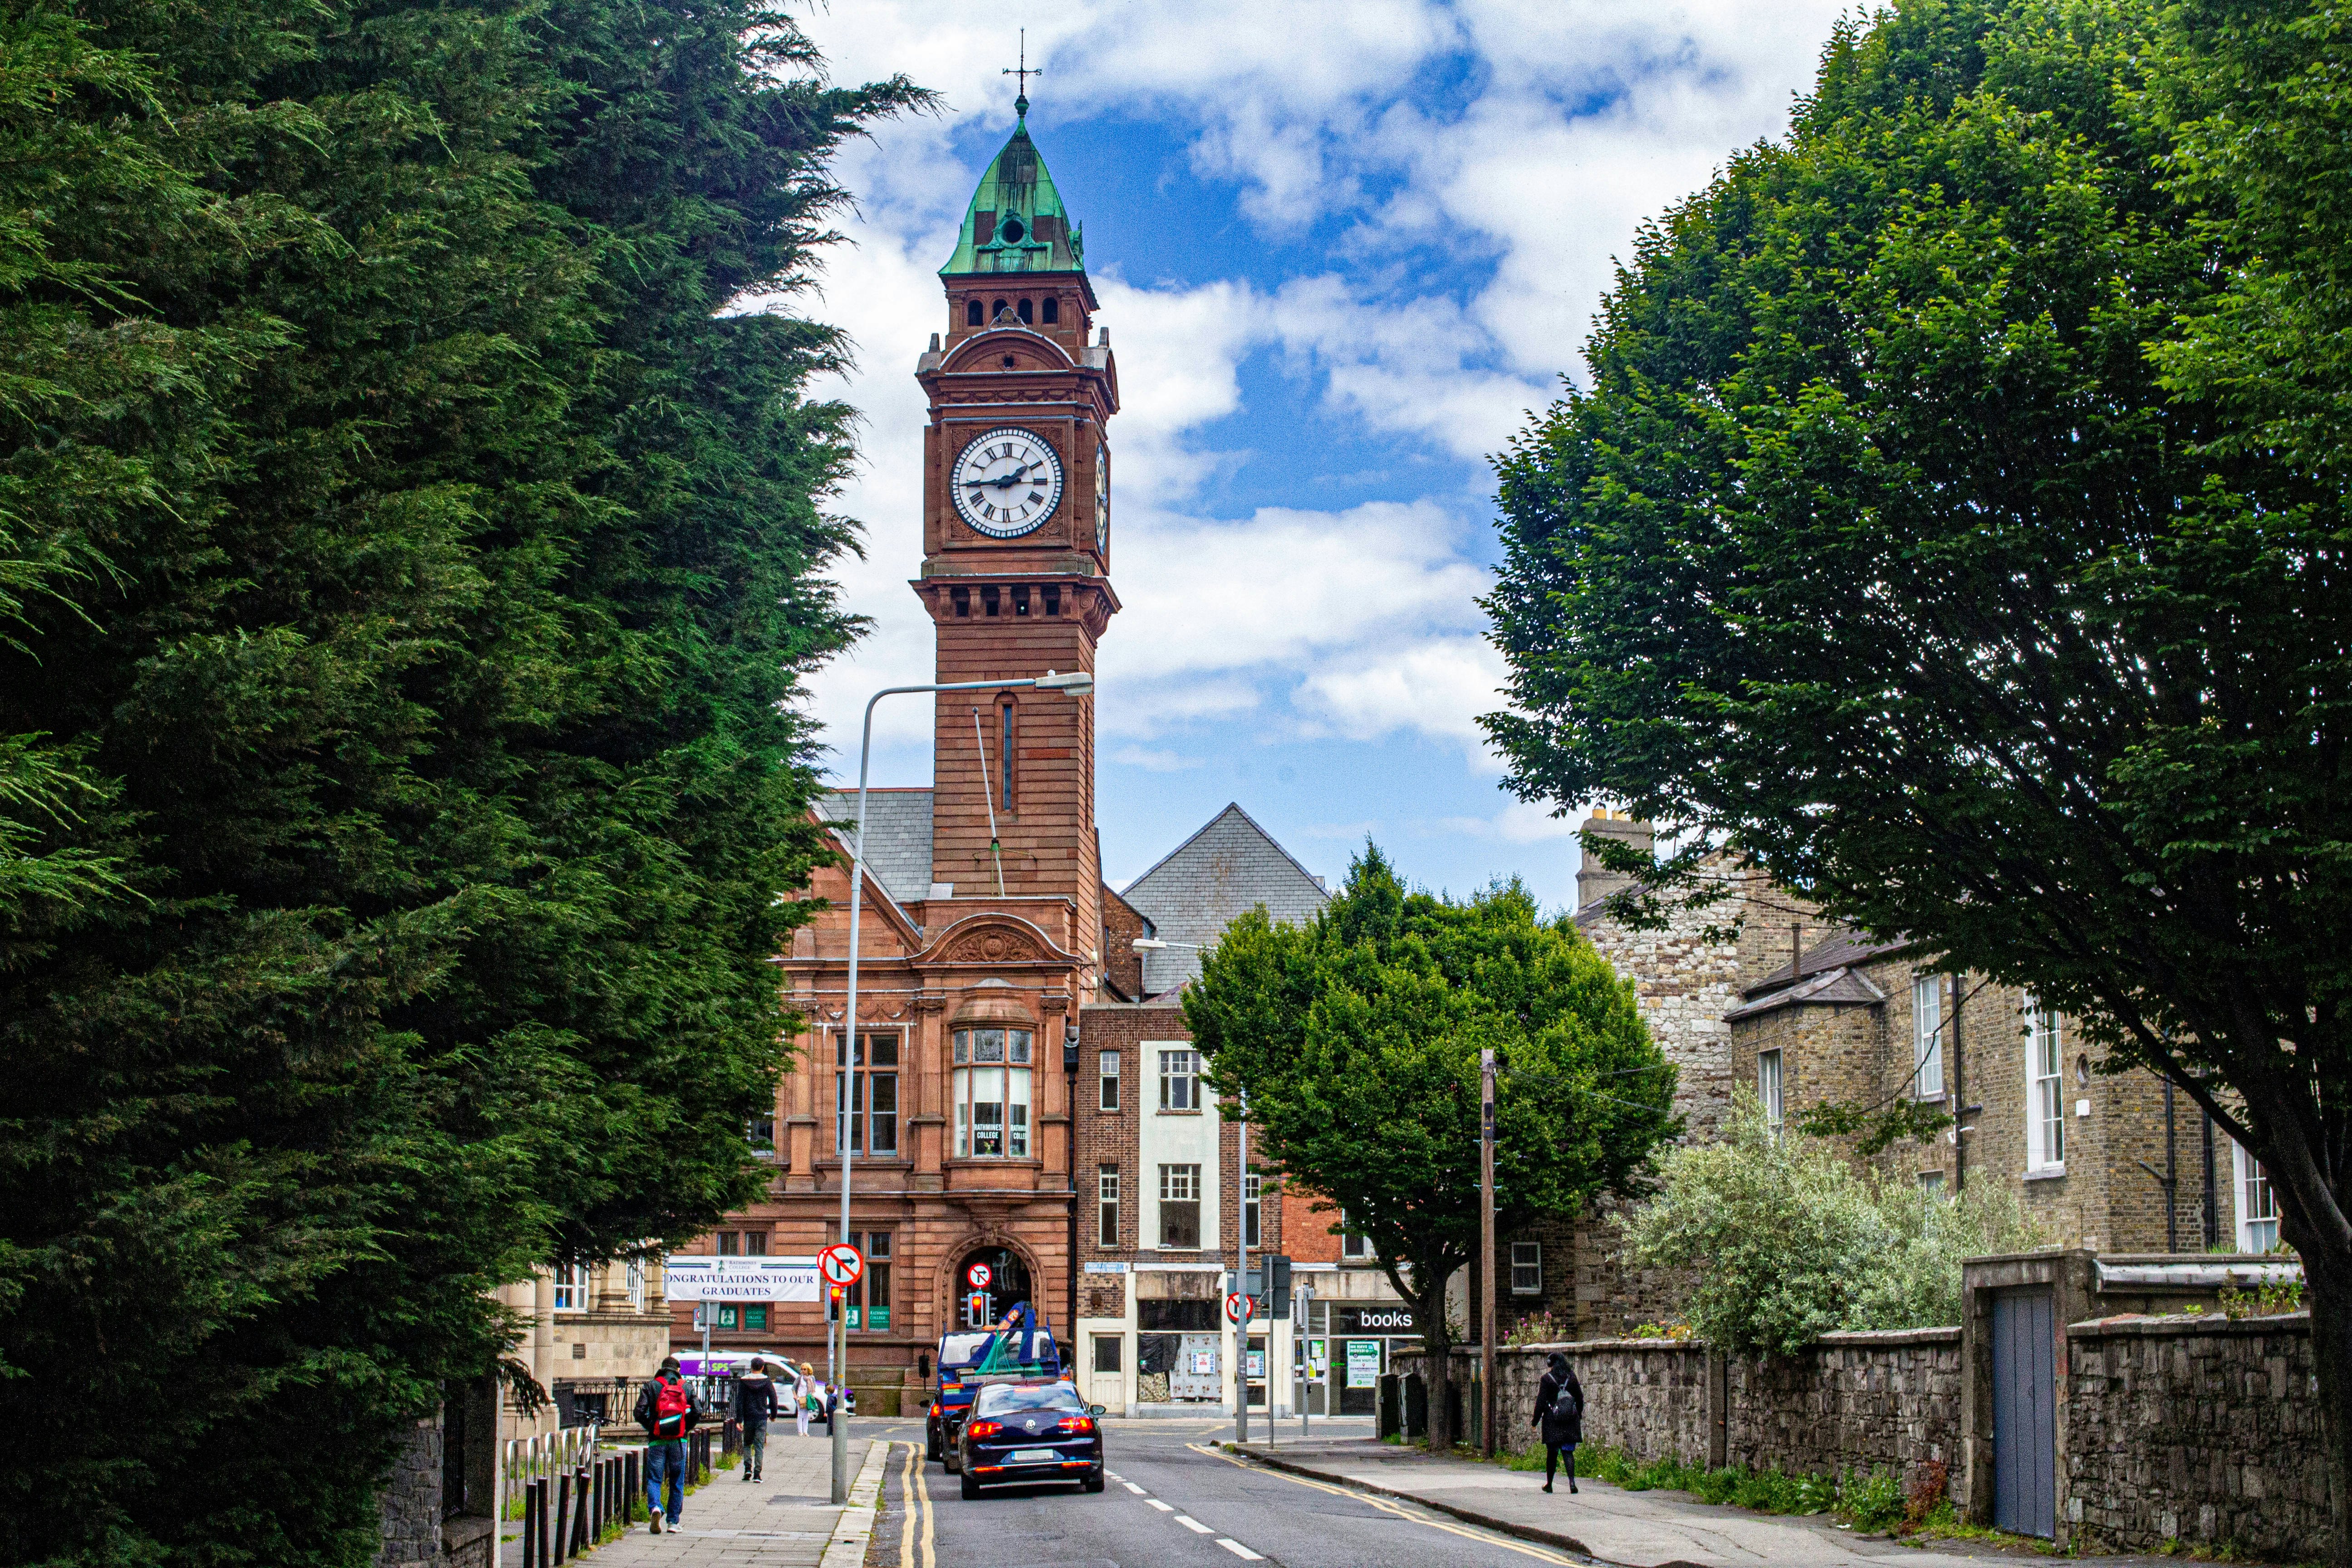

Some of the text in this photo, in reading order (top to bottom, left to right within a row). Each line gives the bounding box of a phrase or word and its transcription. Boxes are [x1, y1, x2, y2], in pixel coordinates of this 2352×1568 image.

[984, 447, 998, 463] XI
[1003, 442, 1012, 457] XII
[1021, 447, 1029, 459] I
[971, 461, 985, 471] X
[1029, 460, 1043, 470] II
[983, 503, 996, 520] VII
[1003, 509, 1010, 523] VI
[1020, 504, 1029, 518] V
[668, 1274, 813, 1284] ONGRATULATIONS TO OUR
[702, 1287, 770, 1296] GRADUATES
[1361, 1311, 1412, 1327] books
[712, 1362, 729, 1372] SPS
